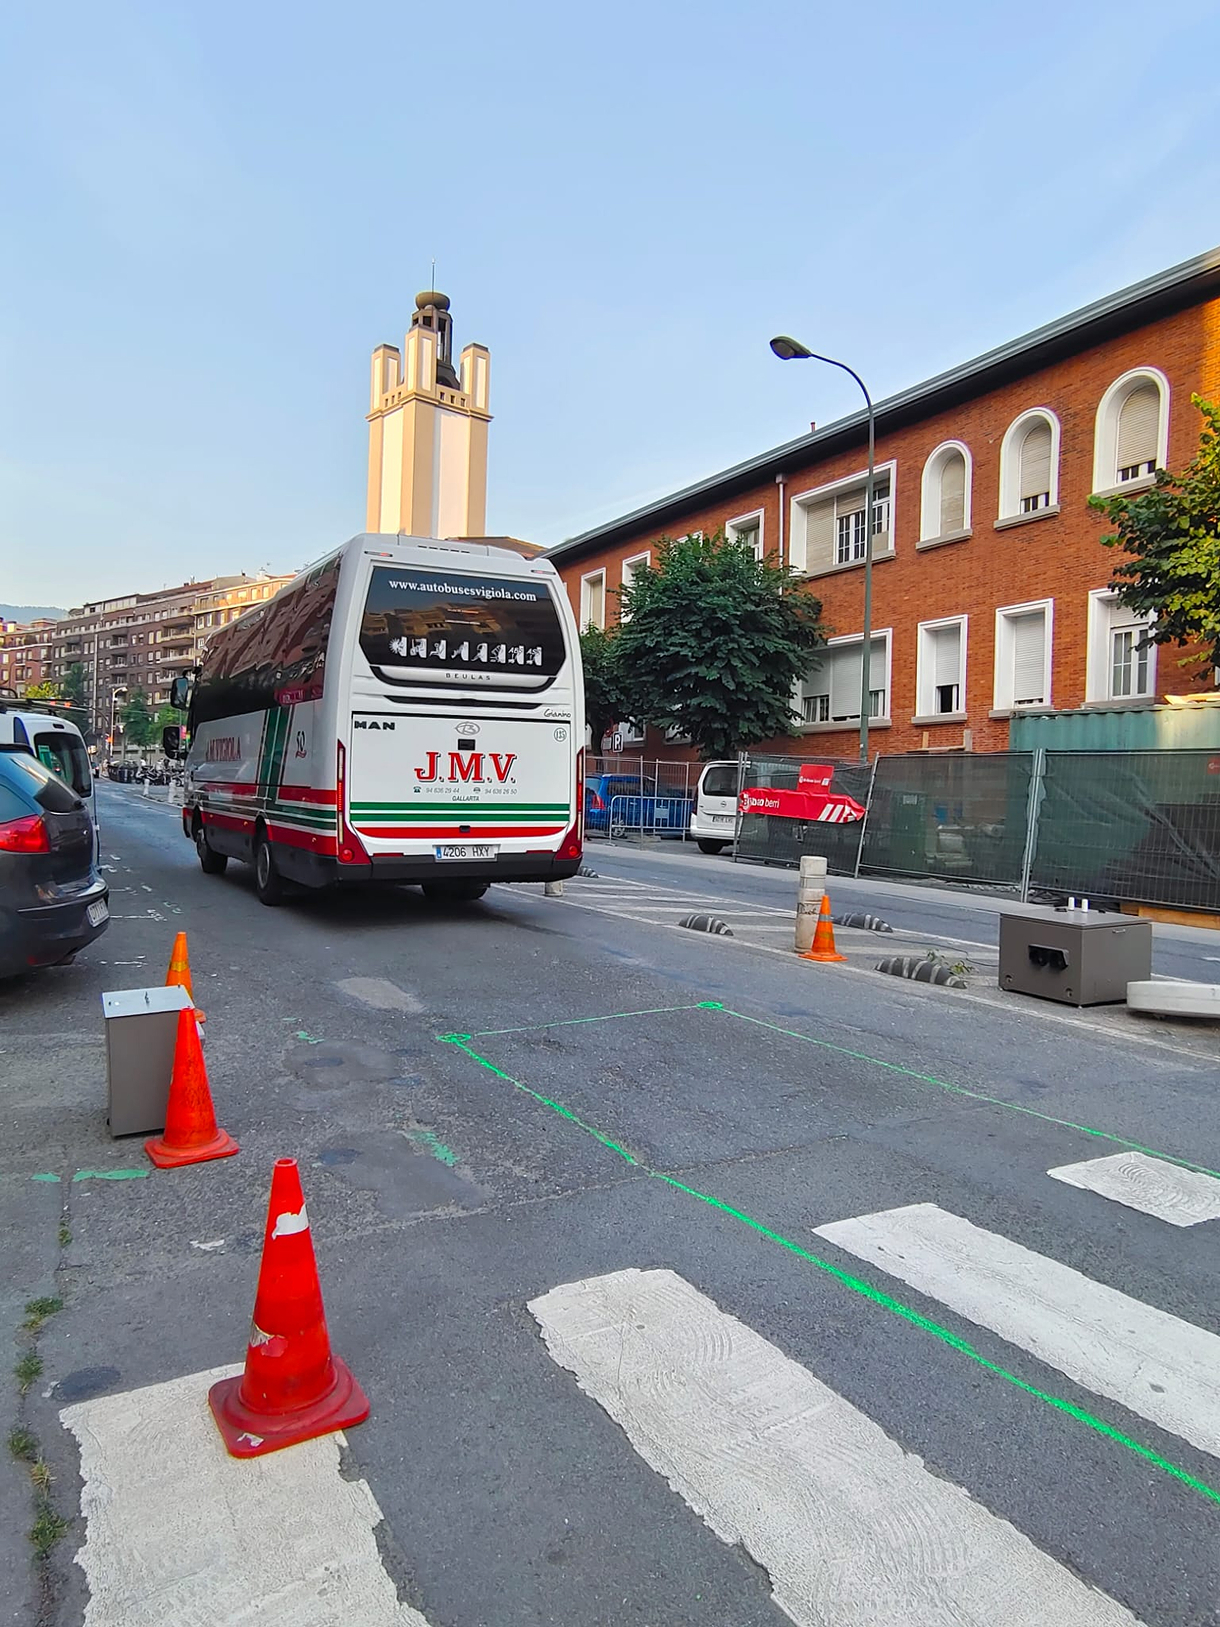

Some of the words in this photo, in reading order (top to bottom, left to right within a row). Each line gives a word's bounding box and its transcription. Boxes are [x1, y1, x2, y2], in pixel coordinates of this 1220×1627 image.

[388, 580, 537, 602] www.autobusesvigiola.com
[445, 673, 491, 681] BEULAS
[354, 720, 396, 731] MAN
[413, 751, 517, 783] J.M.V.
[764, 797, 780, 809] berri
[442, 846, 467, 857] 4206
[472, 846, 490, 857] HXY
